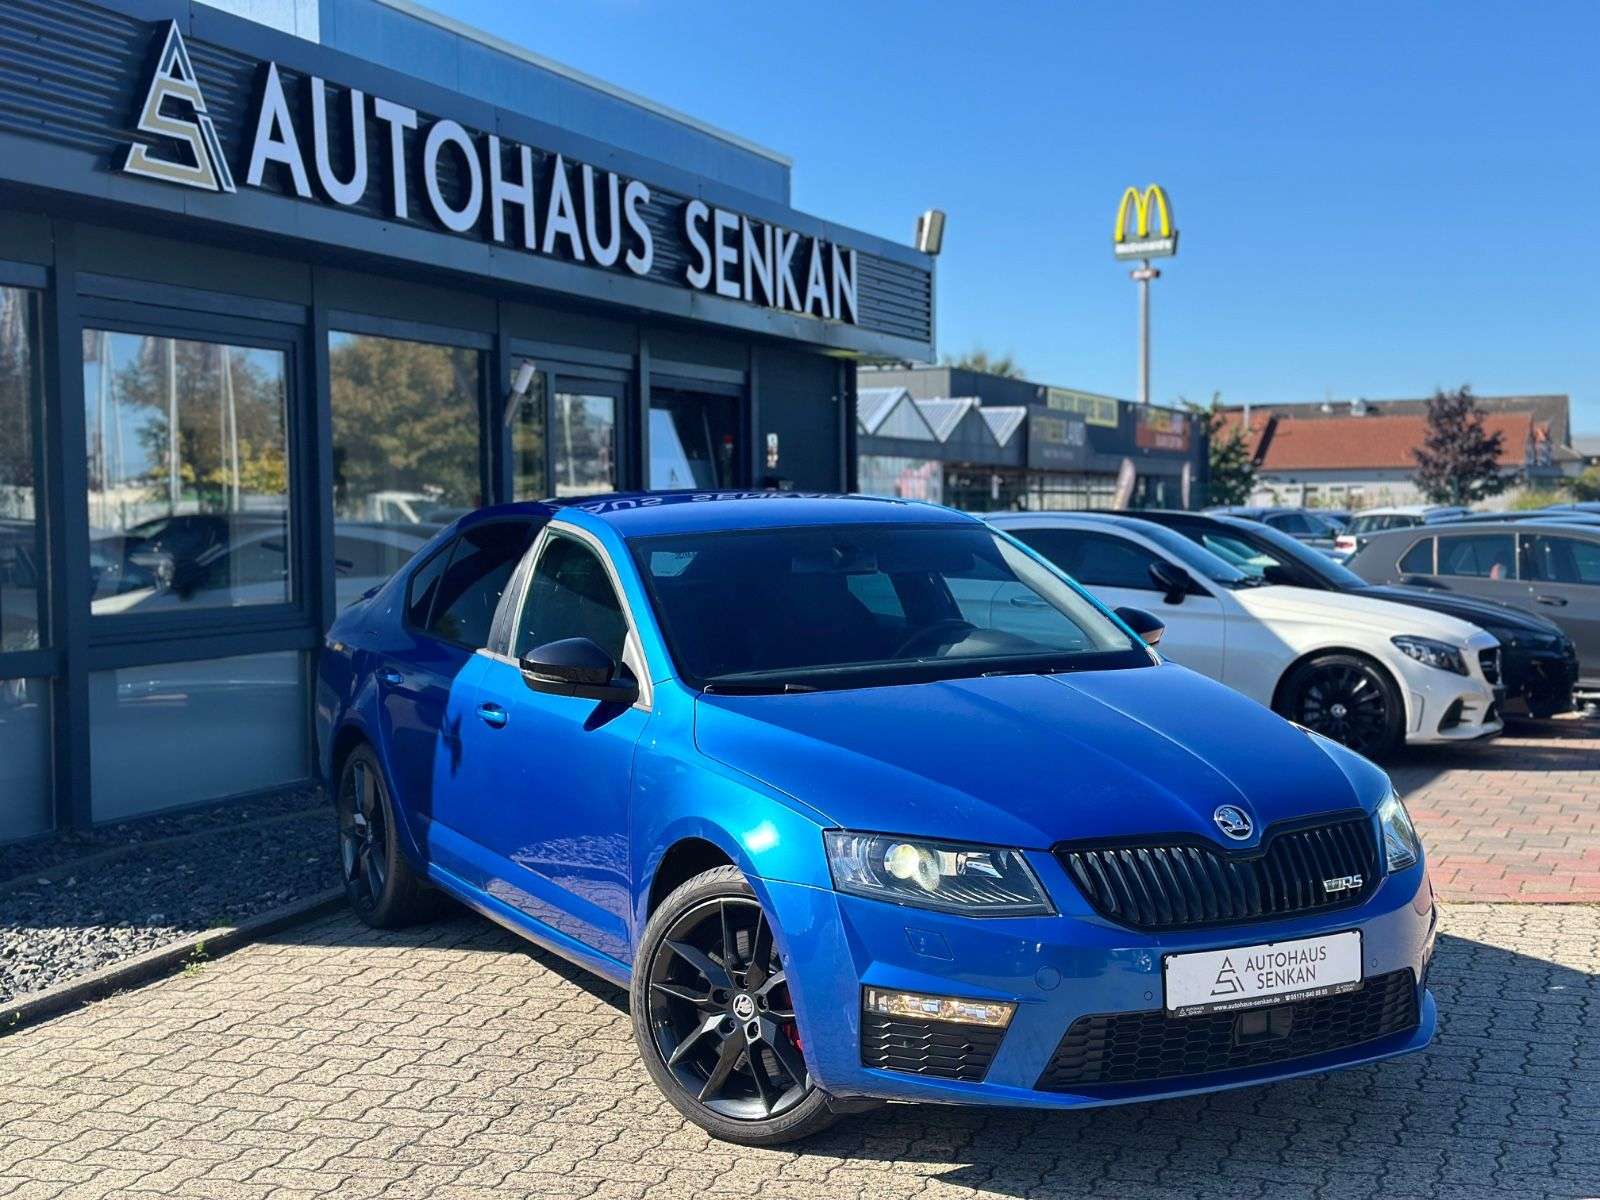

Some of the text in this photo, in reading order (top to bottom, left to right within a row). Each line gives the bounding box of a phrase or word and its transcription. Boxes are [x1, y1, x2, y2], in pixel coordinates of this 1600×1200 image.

[246, 61, 654, 276] AUTOHAUS
[685, 199, 859, 326] SENKAN
[1245, 945, 1327, 973] AUTOHAUS
[1256, 964, 1316, 990] SENKAN
